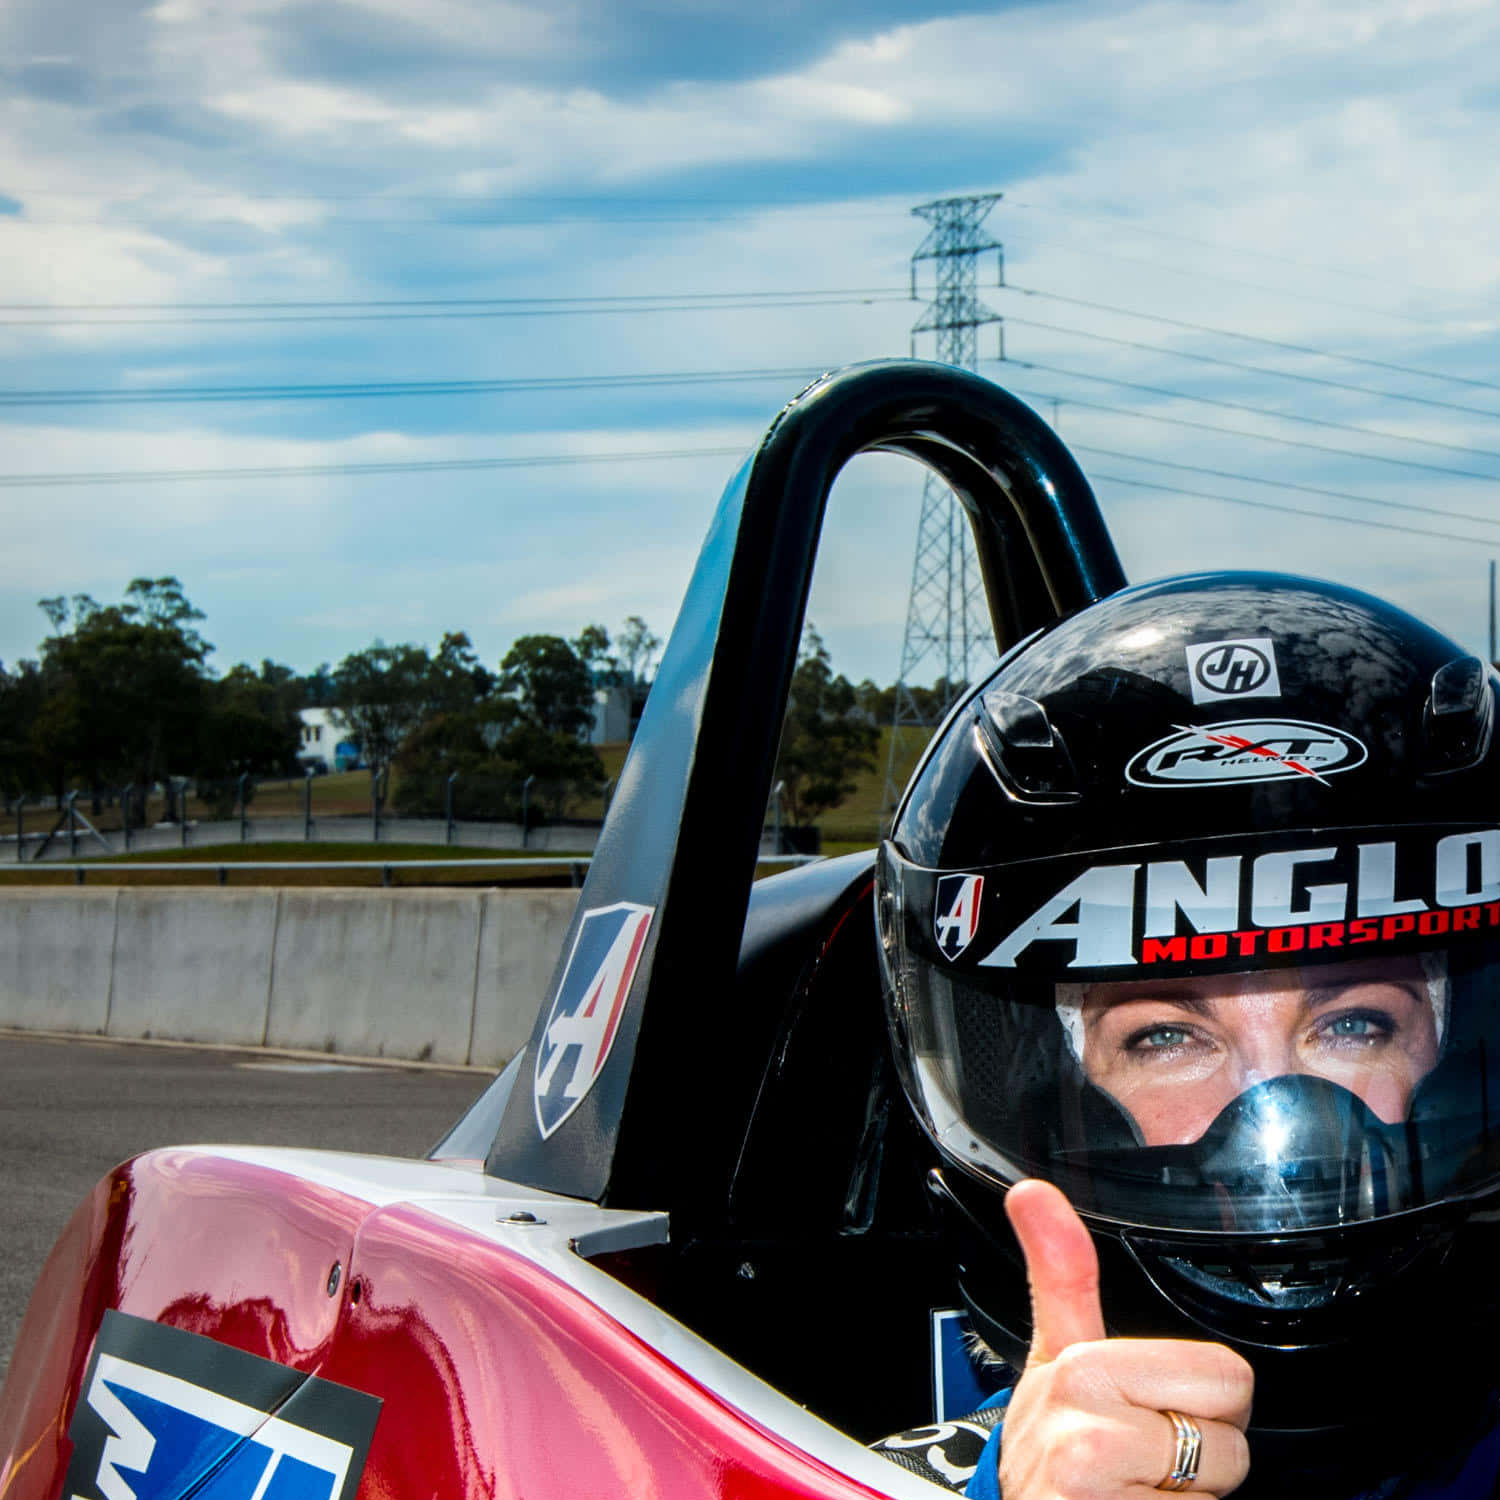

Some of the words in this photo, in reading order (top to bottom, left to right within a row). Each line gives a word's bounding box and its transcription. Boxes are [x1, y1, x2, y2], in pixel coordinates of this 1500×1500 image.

[1206, 647, 1259, 691] JH
[1156, 736, 1336, 771] RXT
[1221, 755, 1329, 767] HELMETS
